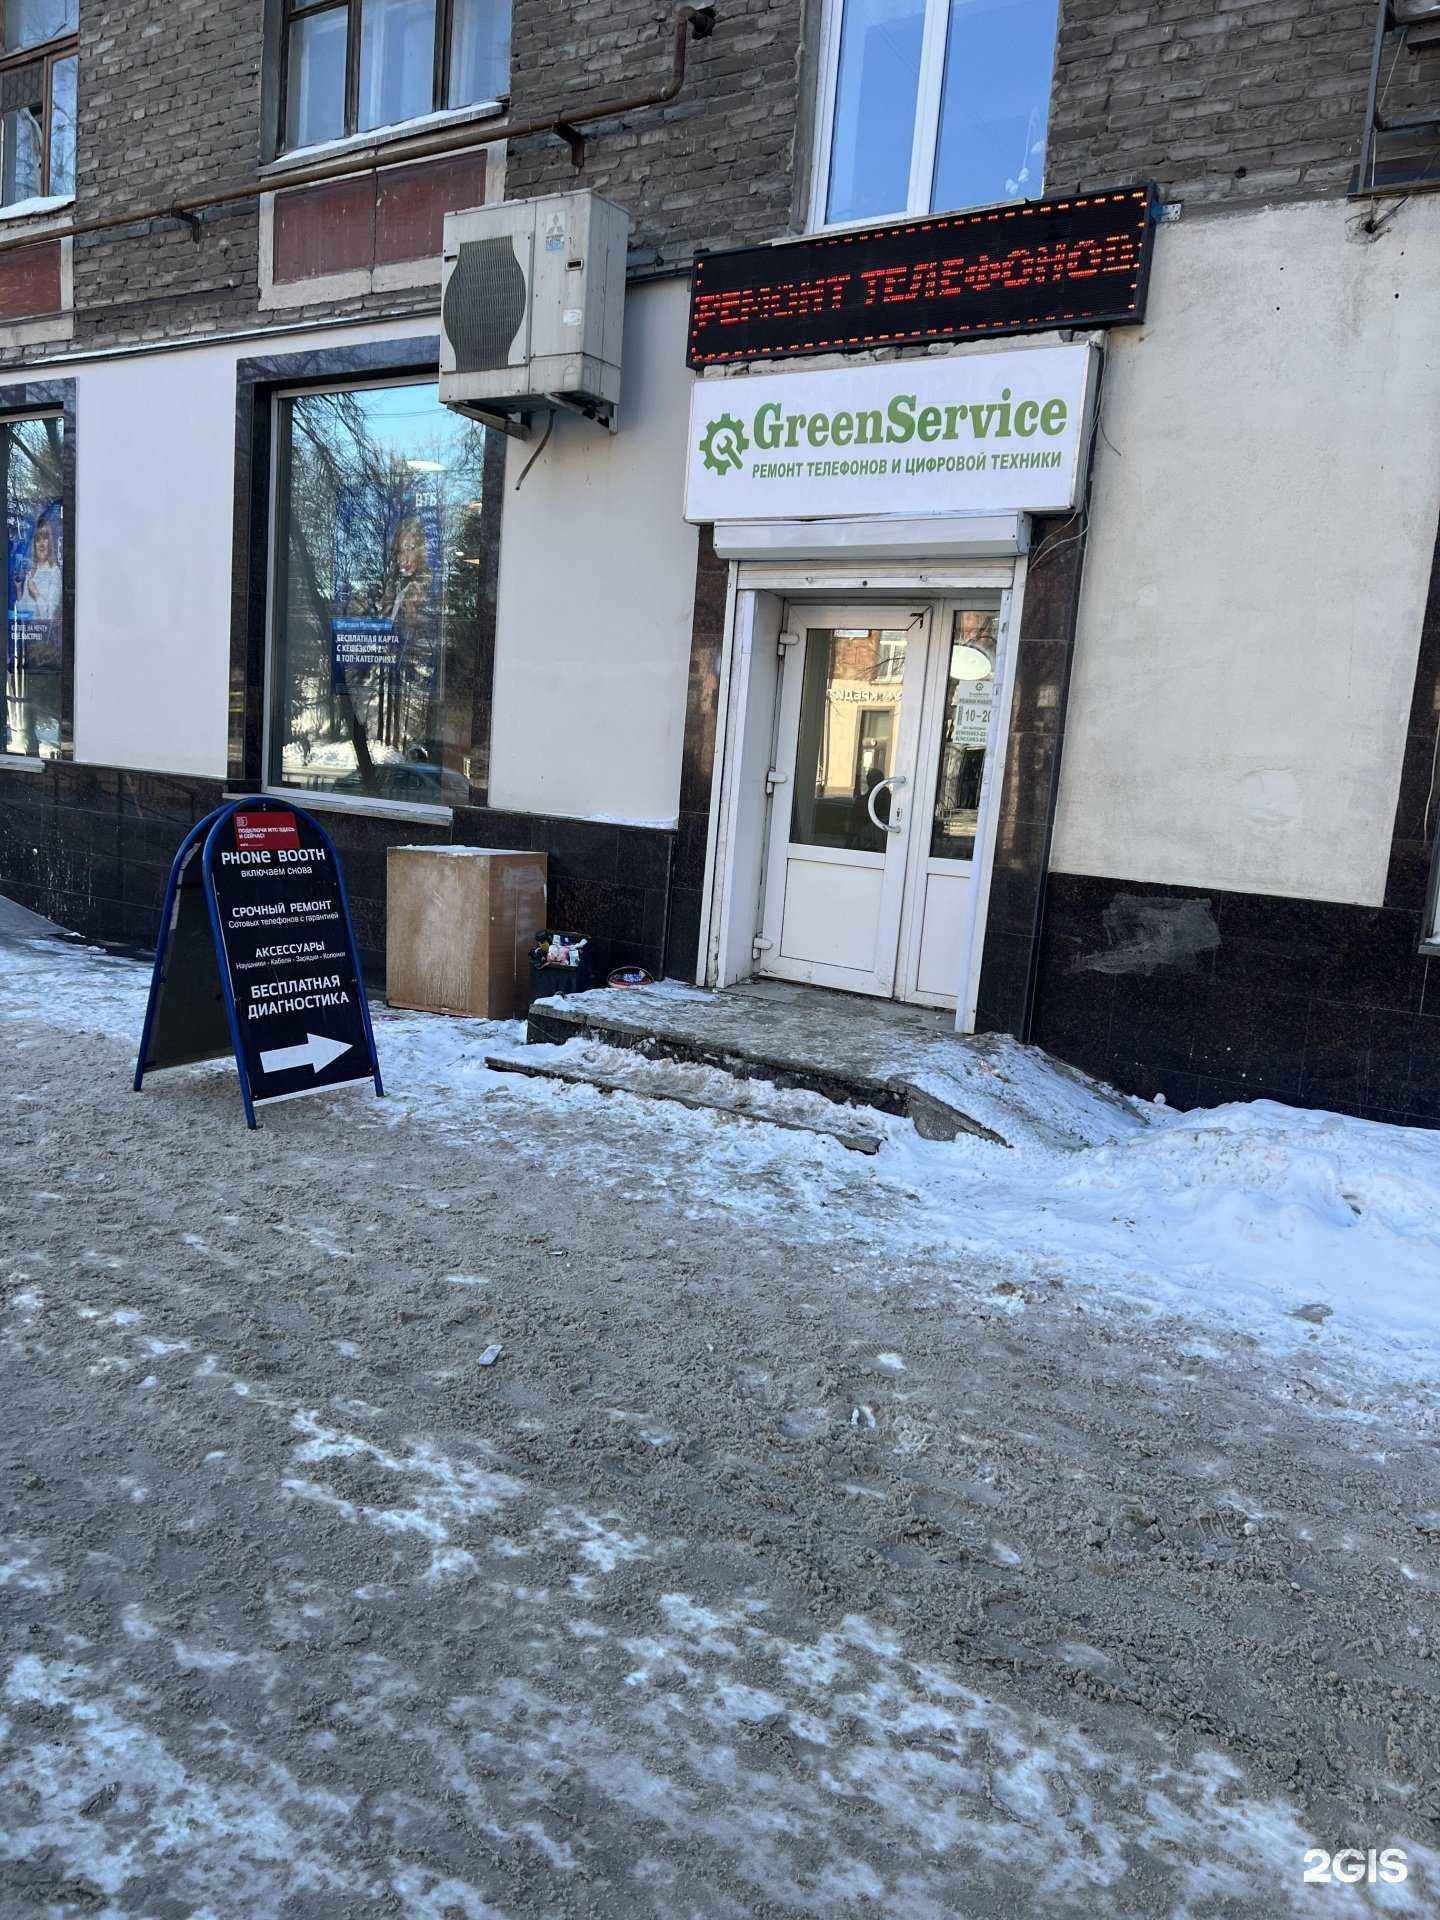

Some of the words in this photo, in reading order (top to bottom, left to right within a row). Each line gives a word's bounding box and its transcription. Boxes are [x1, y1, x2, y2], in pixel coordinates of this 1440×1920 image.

[694, 272, 851, 327] РЕМОНТ
[861, 234, 1135, 305] ТЕЛЕФОНОВ
[752, 387, 1068, 449] GreenService
[752, 462, 803, 479] РЕМОНТ
[807, 459, 888, 477] ТЕЛЕФОНОВ
[891, 459, 902, 474] И
[905, 451, 987, 475] ЦИФРОВОЙ
[991, 451, 1063, 470] ТЕХНИКИ
[336, 634, 377, 643] БЕСПЛАТНАЯ
[378, 635, 399, 644] КАРТА
[278, 848, 326, 862] BOOTH
[241, 867, 286, 878] включаем
[287, 866, 313, 875] снова
[232, 902, 286, 918] СРОЧНЫЙ
[290, 900, 332, 913] РЕМОНТ
[228, 919, 260, 929] Сотовых
[261, 916, 299, 928] телефонов
[305, 911, 339, 922] гарантией
[255, 941, 325, 958] АКСЕССУАРЫ
[235, 960, 266, 970] Наушники
[250, 974, 341, 999] БЕСПЛАТНАЯ
[247, 991, 349, 1020] ДИАГНОСТИКА
